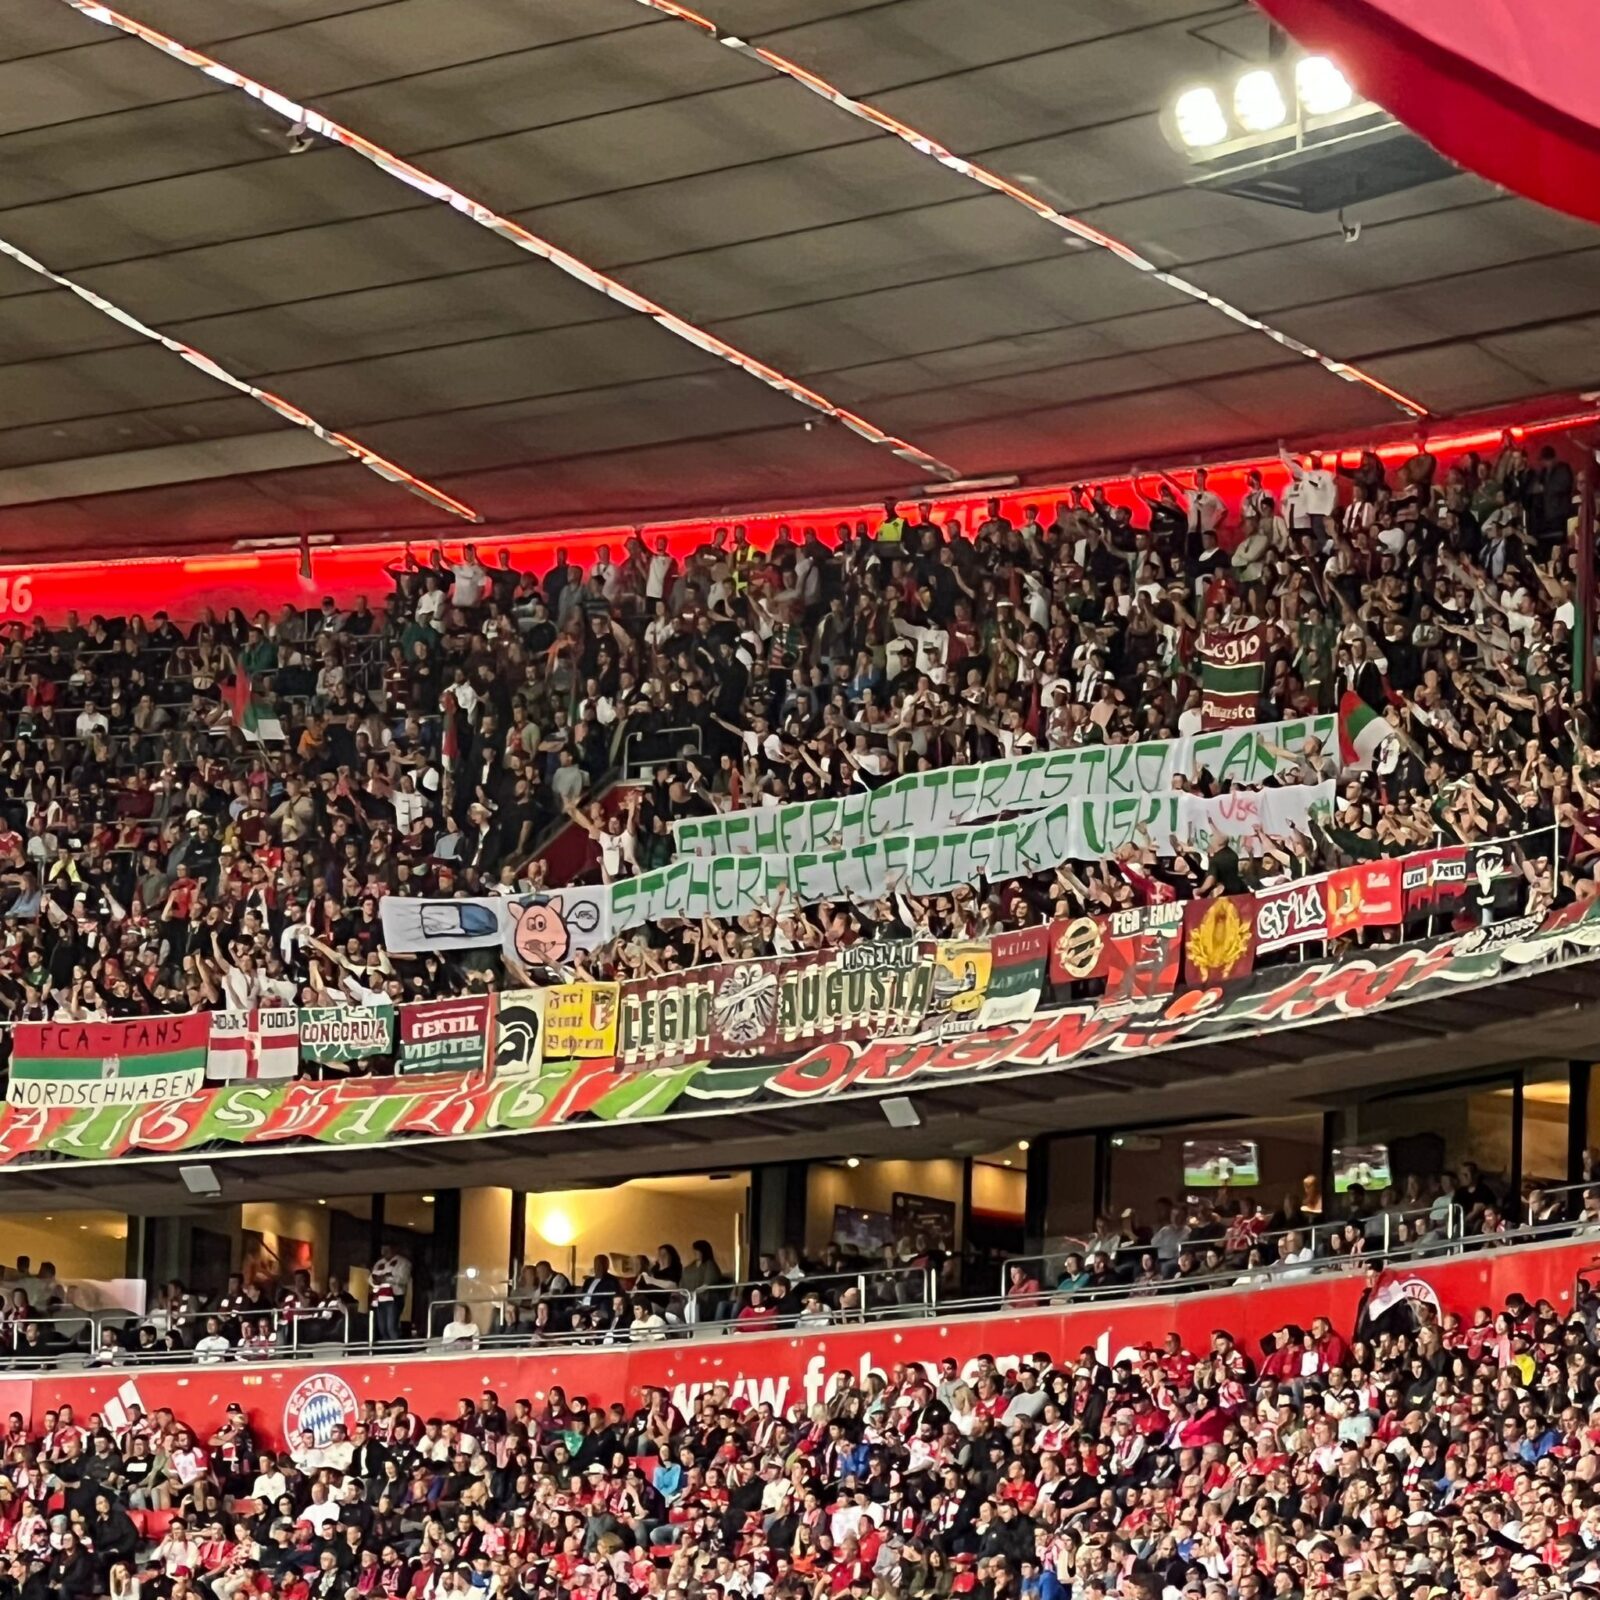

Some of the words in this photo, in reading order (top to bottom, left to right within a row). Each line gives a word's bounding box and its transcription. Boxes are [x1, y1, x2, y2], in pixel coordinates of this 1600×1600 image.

[40, 1027, 89, 1051] FCA
[123, 1020, 184, 1049] FANS
[302, 1019, 386, 1043] CONCORDIA
[621, 990, 713, 1052] LEGIO
[13, 1072, 197, 1106] NORDSCHWABEN
